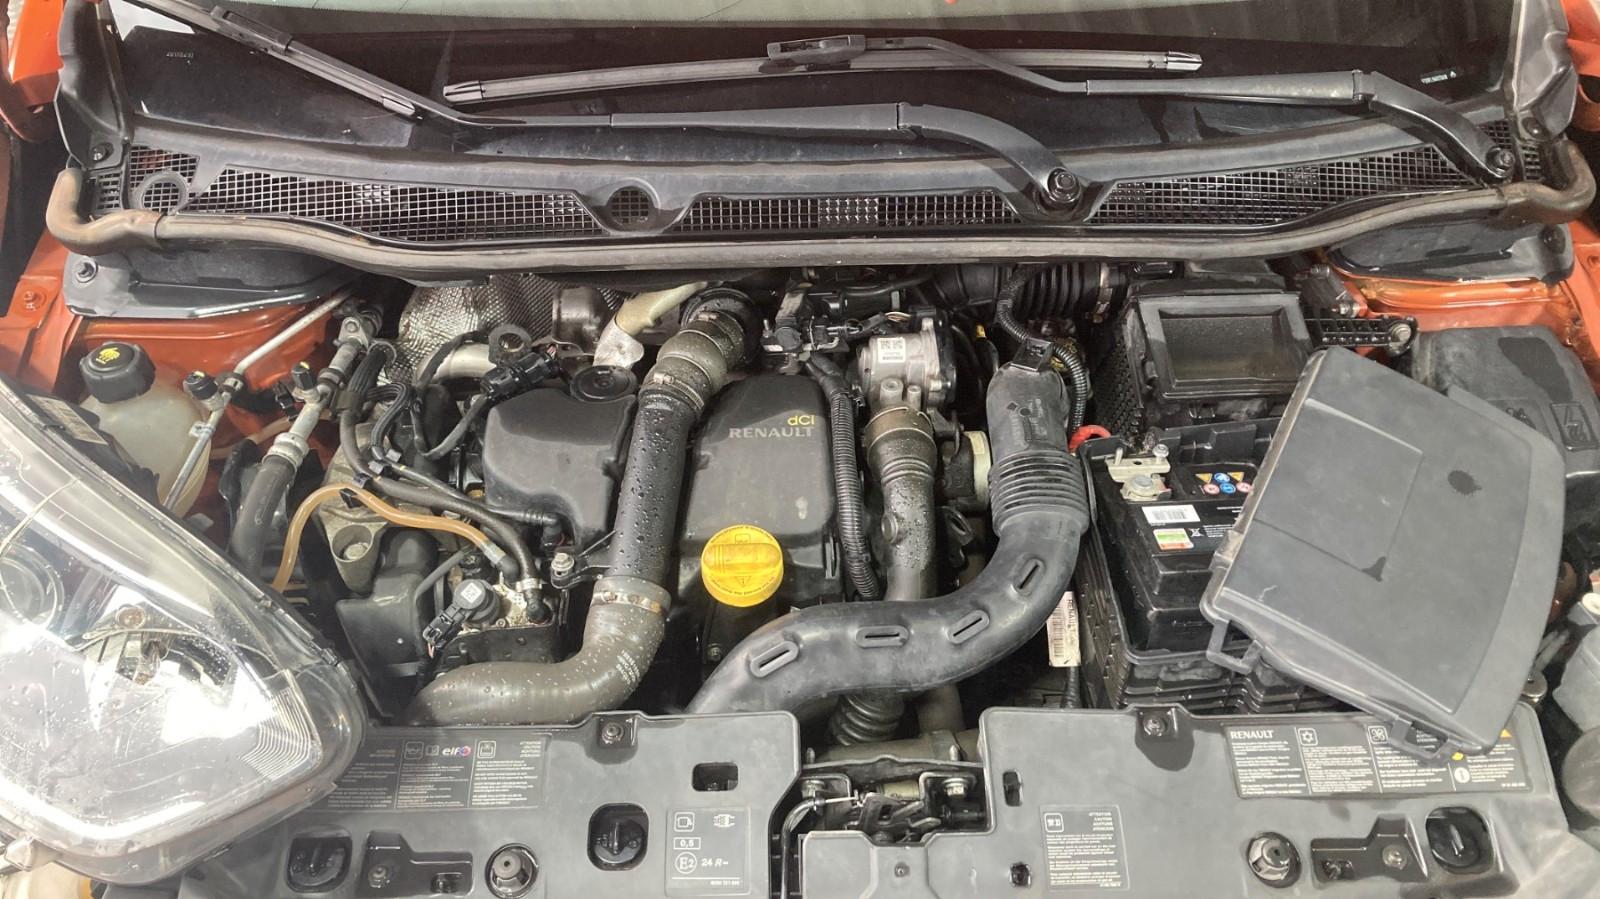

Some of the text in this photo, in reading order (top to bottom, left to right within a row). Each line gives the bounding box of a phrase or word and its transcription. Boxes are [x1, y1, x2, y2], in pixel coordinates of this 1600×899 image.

[728, 427, 814, 438] RENAULT
[1230, 730, 1274, 740] RENAULT
[442, 746, 461, 756] elf
